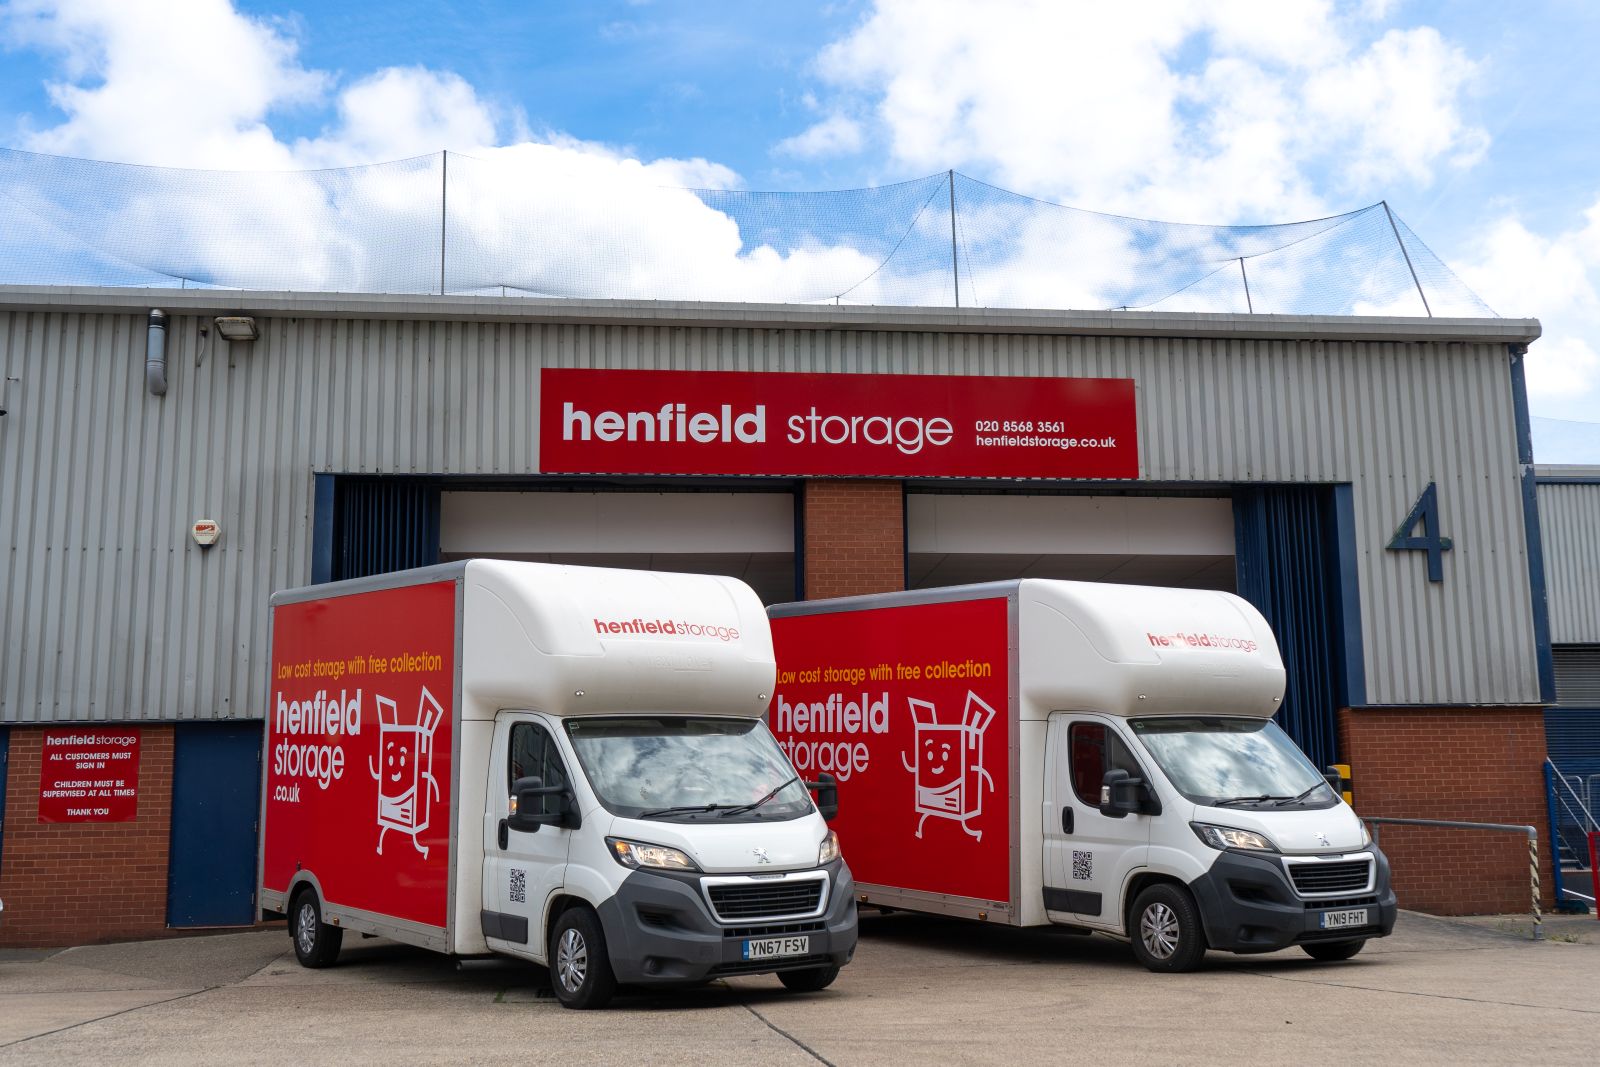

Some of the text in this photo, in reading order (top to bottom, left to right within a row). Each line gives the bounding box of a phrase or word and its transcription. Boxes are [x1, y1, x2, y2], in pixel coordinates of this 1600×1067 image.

[563, 401, 954, 455] henfield storage
[975, 420, 1065, 433] 020 8568 3561
[975, 435, 1116, 450] henfieldstorage.co.uk
[1385, 482, 1452, 583] 4
[278, 651, 442, 680] Low cost storage with free collection
[777, 659, 991, 685] Low cost storage with free collection
[276, 688, 363, 736] henfield
[777, 691, 889, 734] henfield
[50, 752, 132, 761] ALL CUSTOMERS MUST
[274, 737, 345, 790] storage
[54, 780, 92, 788] CHILDREN
[94, 780, 114, 788] MUST
[273, 782, 301, 803] .co.uk
[42, 790, 86, 798] SUPERVISED
[66, 808, 92, 816] THANK
[1328, 911, 1365, 926] YN19 FHT
[751, 938, 807, 956] YN67 FSV
